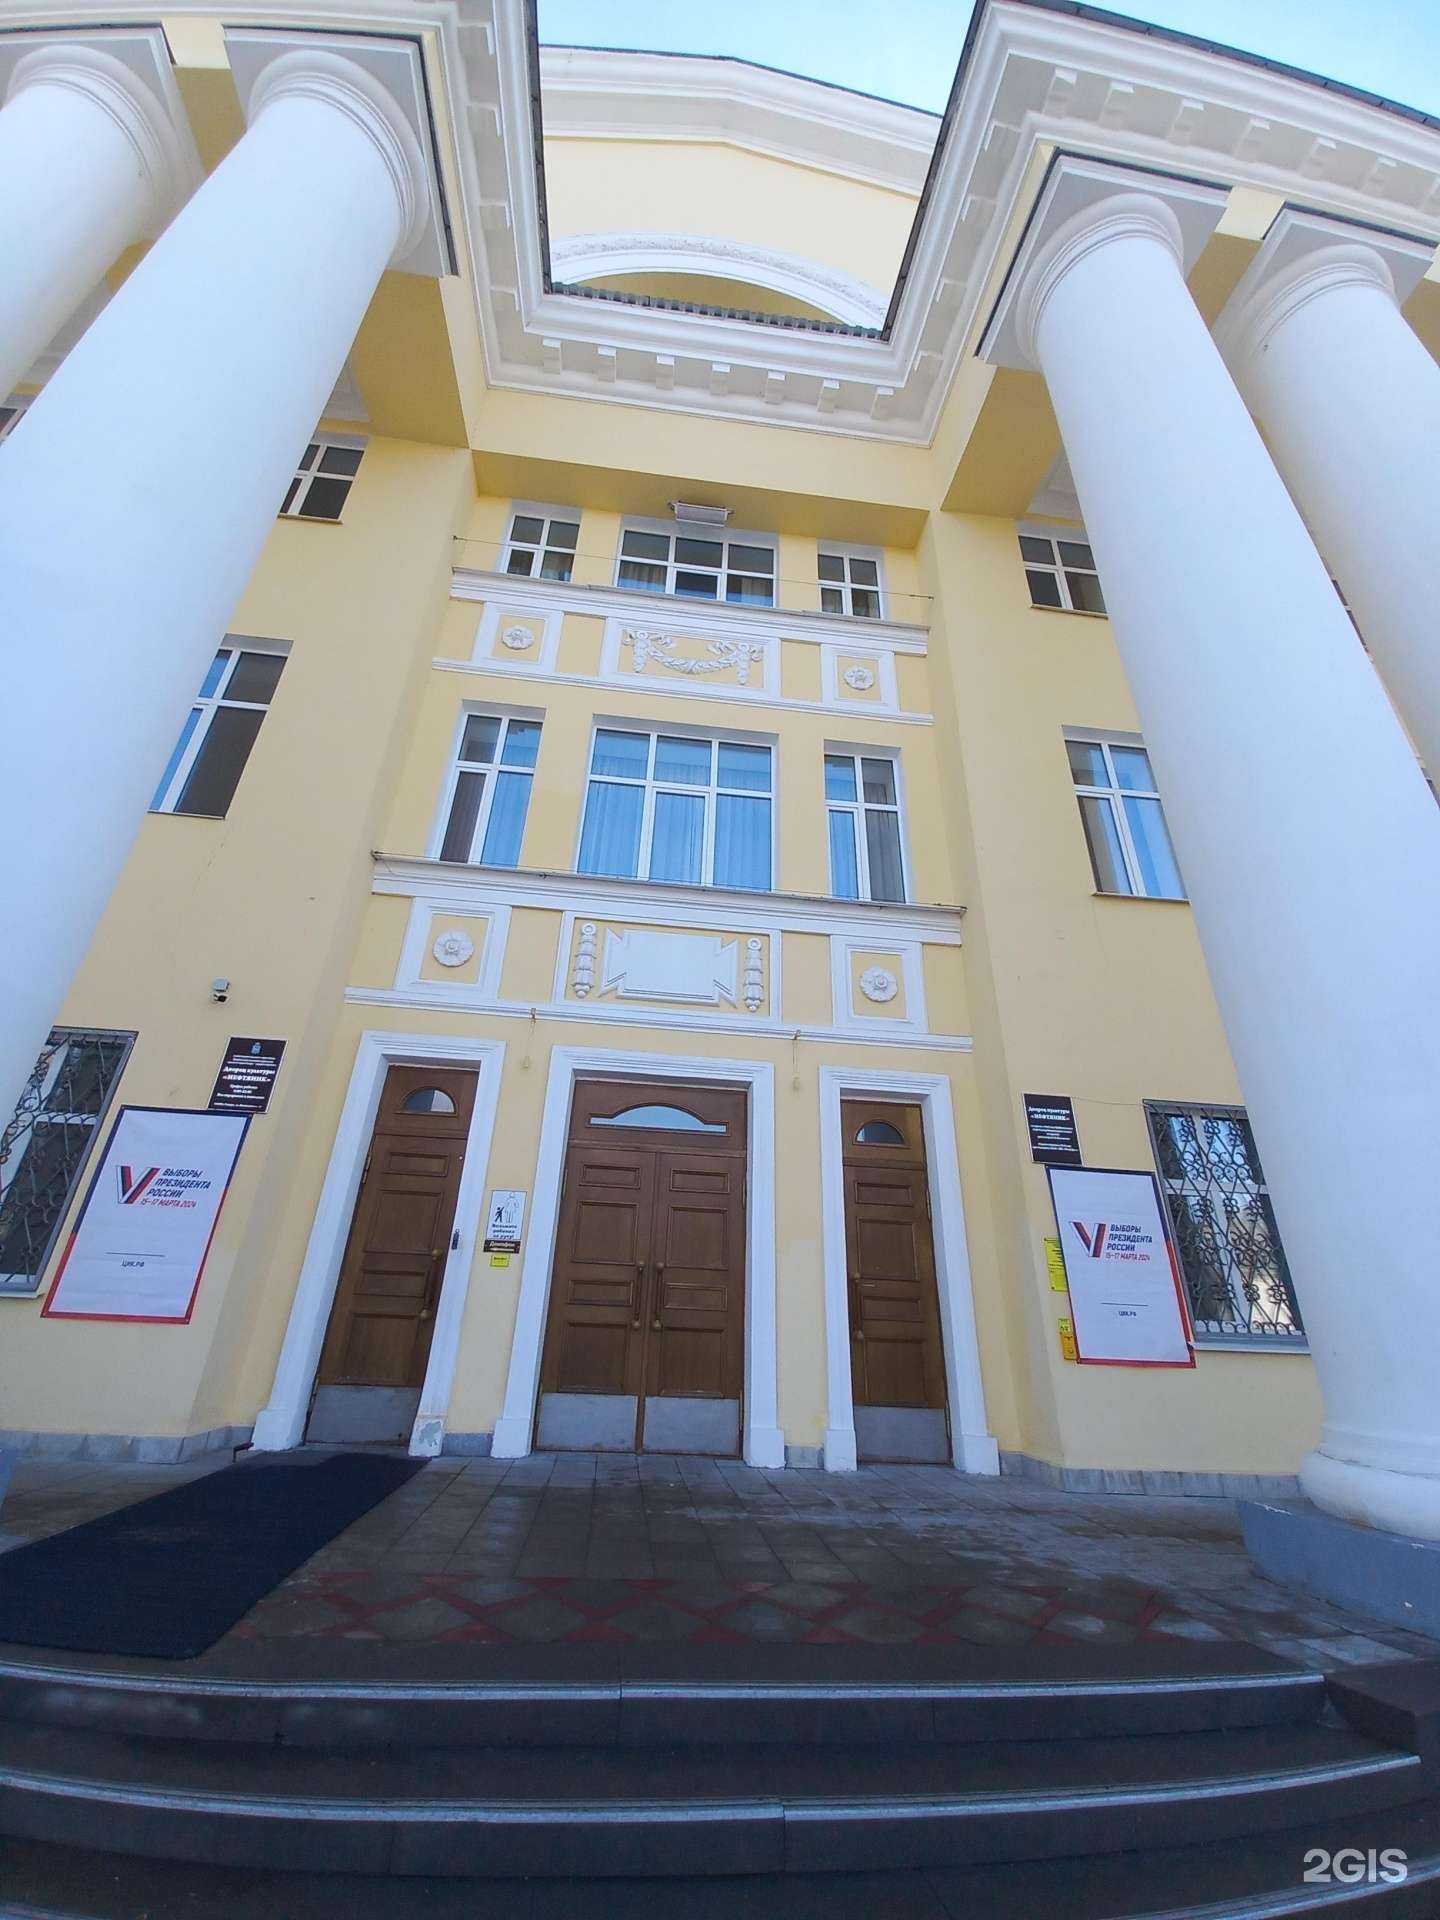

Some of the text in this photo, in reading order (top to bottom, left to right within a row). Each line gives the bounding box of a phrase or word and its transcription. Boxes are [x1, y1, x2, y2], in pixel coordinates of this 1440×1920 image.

[162, 1168, 203, 1178] ВЫБОРЫ
[155, 1178, 211, 1189] ПРЕЗИДЕНТА
[147, 1188, 184, 1198] РОССИИ
[180, 1200, 197, 1208] 2024
[1110, 1224, 1141, 1232] ВЫБОРЫ
[1108, 1233, 1152, 1243] ПРЕЗИДЕНТА
[1107, 1243, 1135, 1251] РОССИИ
[1120, 1252, 1138, 1260] МАРТА
